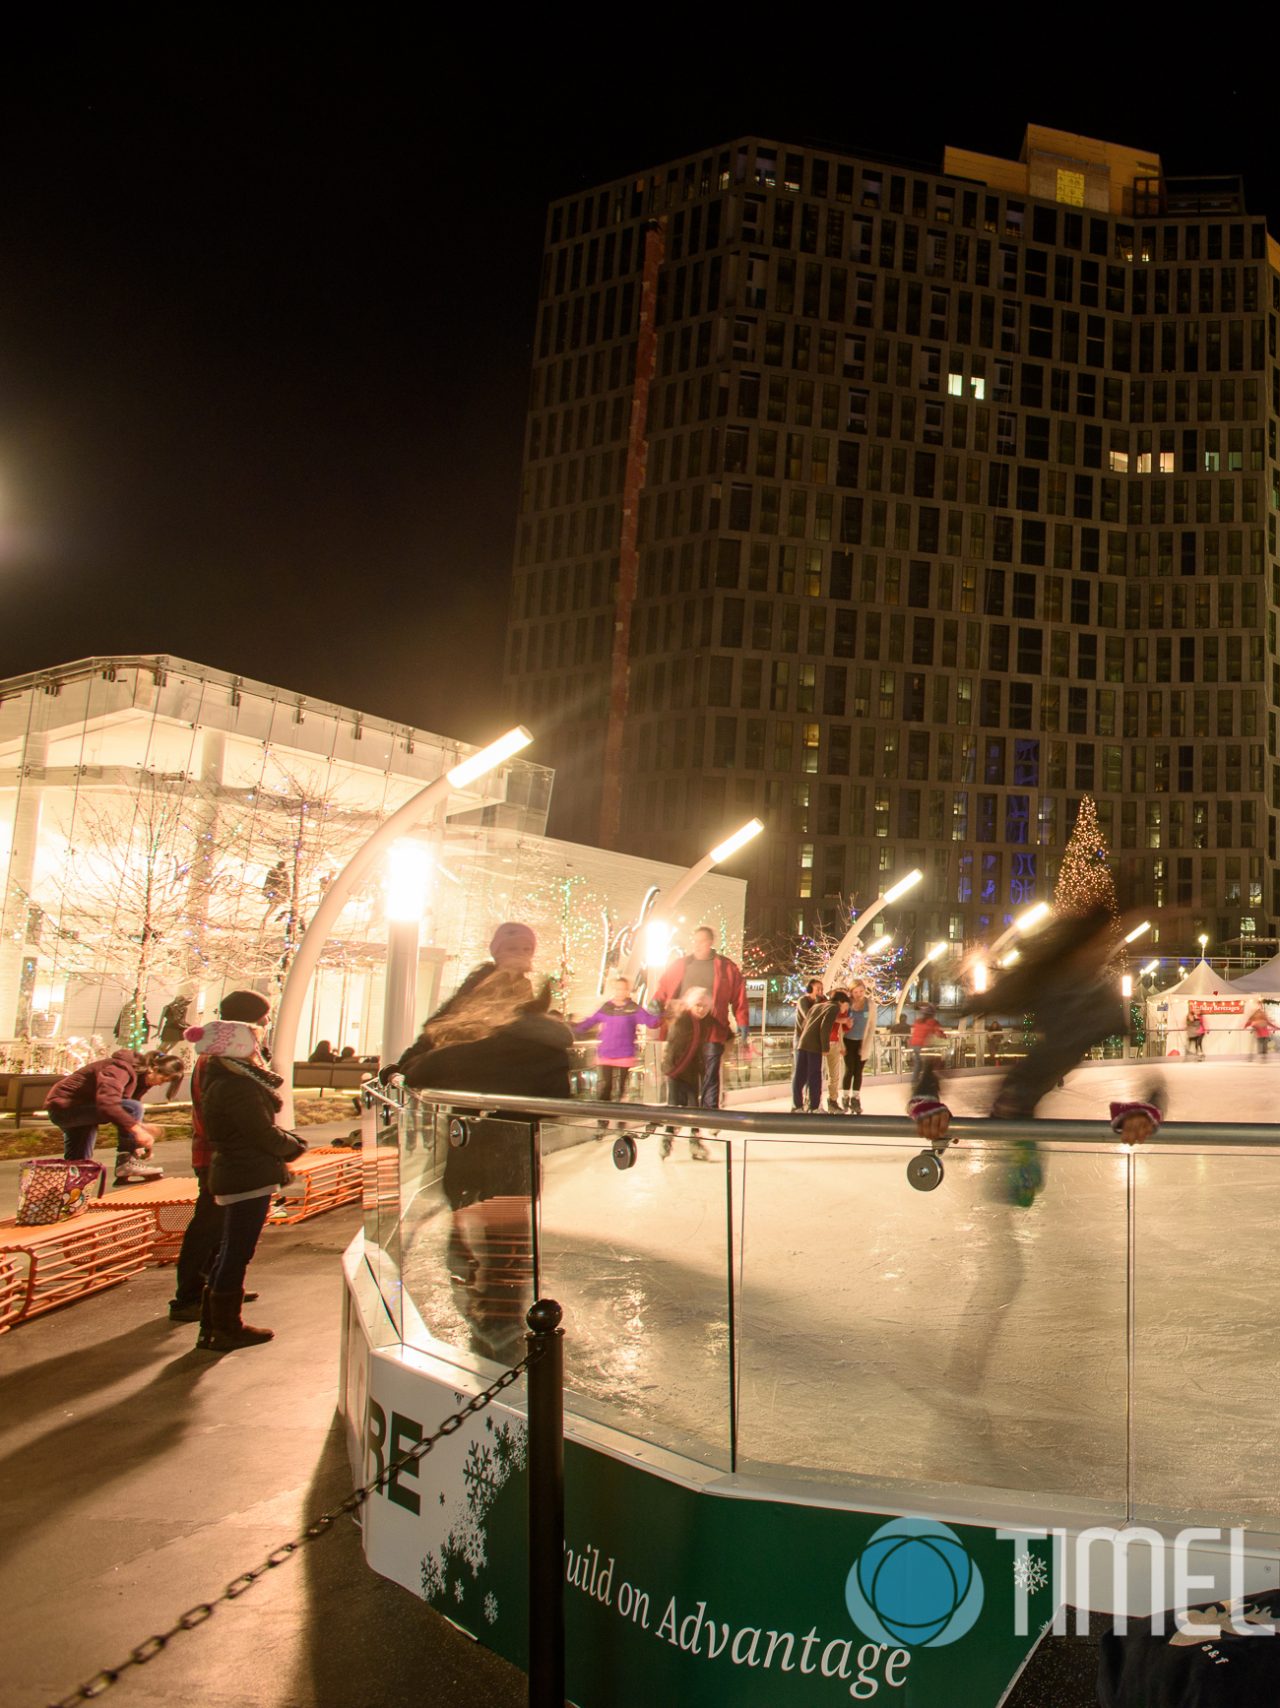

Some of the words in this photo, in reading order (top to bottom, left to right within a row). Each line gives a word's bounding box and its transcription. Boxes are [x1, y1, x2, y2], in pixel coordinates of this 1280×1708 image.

[564, 1540, 615, 1606] uild
[617, 1582, 650, 1629] on
[655, 1595, 912, 1700] Advantage
